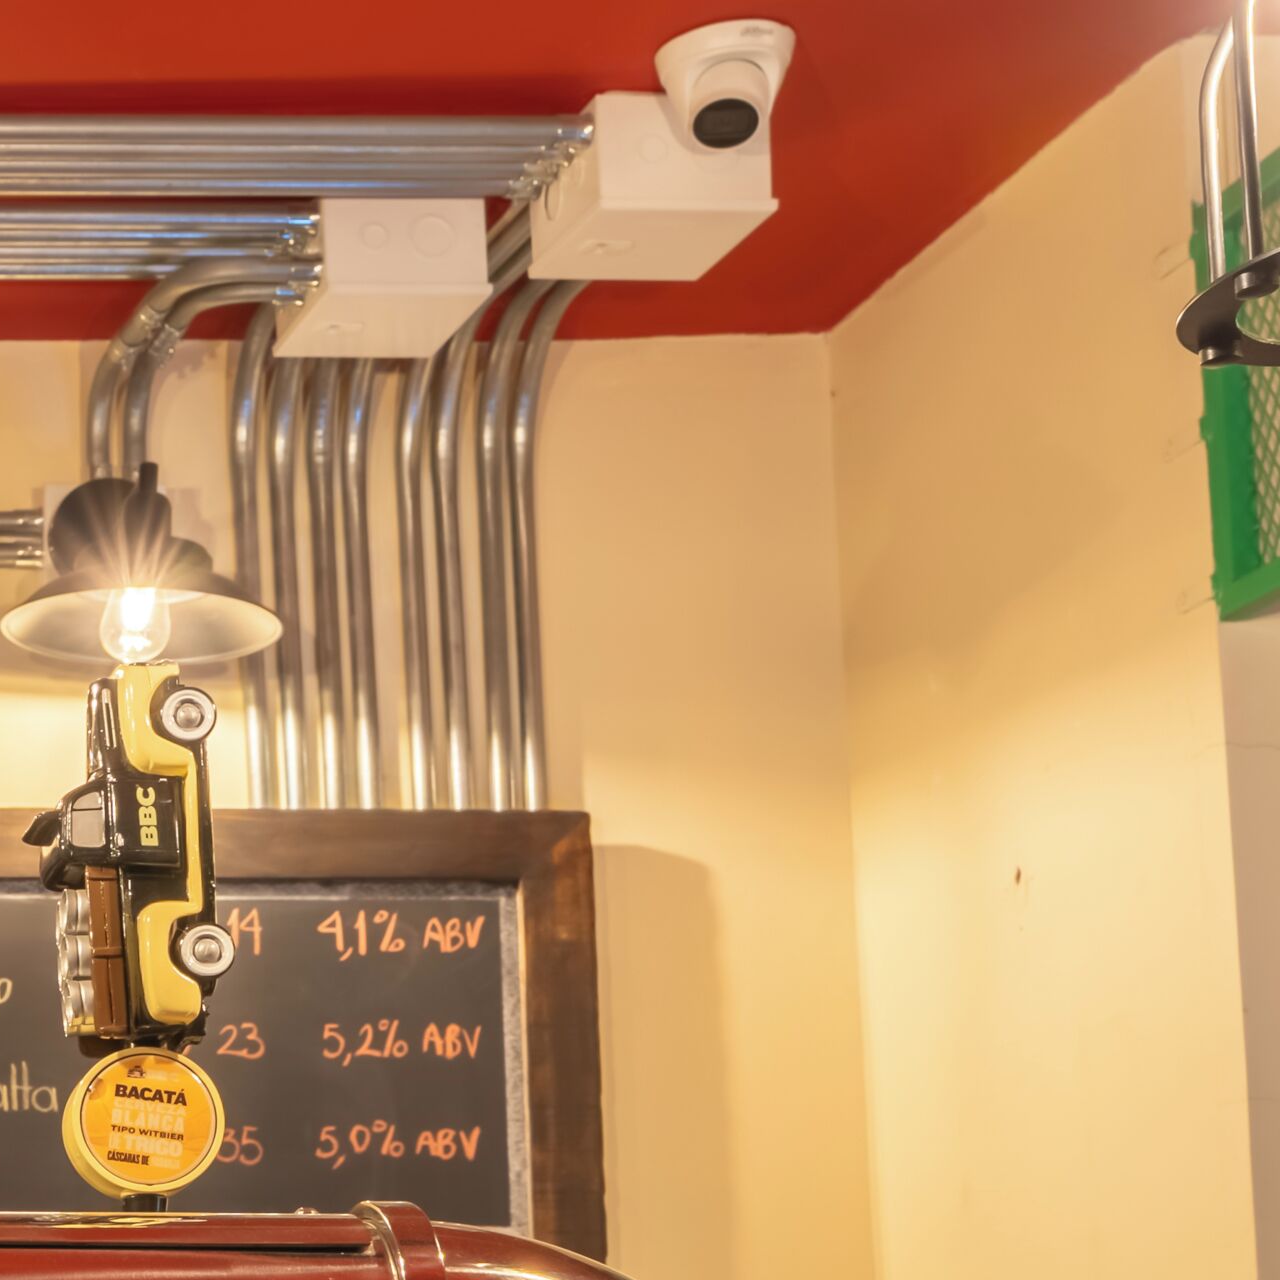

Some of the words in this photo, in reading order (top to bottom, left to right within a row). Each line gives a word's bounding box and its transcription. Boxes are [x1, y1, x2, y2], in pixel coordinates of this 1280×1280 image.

[140, 785, 158, 847] BBC
[422, 915, 486, 953] ABV
[216, 1022, 267, 1060] 23
[322, 1018, 408, 1066] 5,2%
[422, 1024, 483, 1060] ABV
[114, 1084, 188, 1107] BACATÁ
[111, 1107, 185, 1132] BLANCA
[111, 1125, 136, 1134] TIPO
[139, 1128, 184, 1141] WITBIER
[315, 1120, 405, 1169] 5,0%
[415, 1126, 482, 1161] ABV
